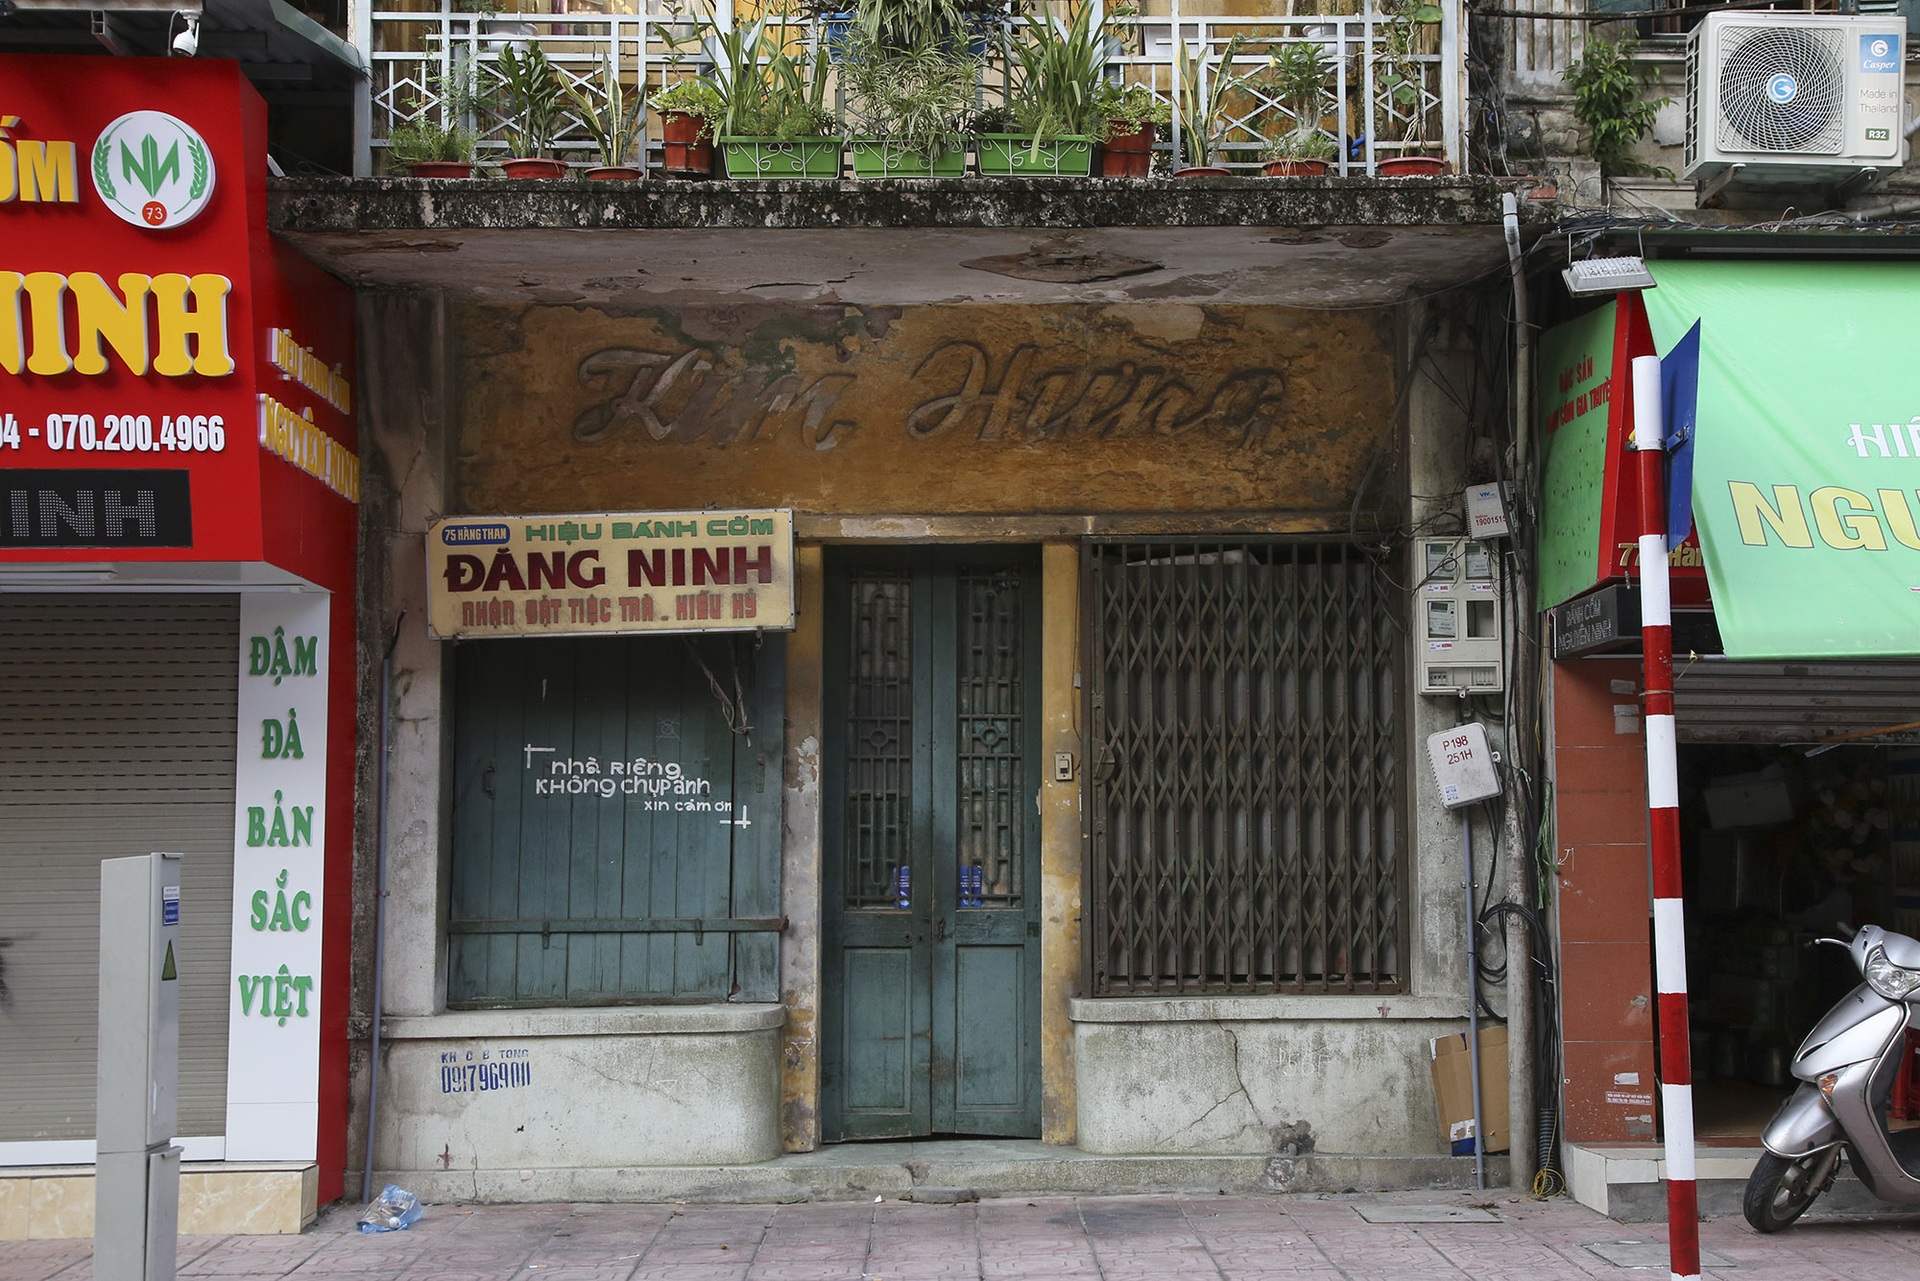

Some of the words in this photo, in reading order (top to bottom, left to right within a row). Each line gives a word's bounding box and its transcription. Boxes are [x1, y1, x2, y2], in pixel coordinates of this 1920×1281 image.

[1863, 60, 1895, 71] Casper
[1860, 90, 1886, 99] Made
[1889, 90, 1897, 99] in
[1860, 103, 1898, 113] Thailand
[1869, 131, 1886, 139] R32
[145, 207, 163, 220] 73
[0, 271, 235, 376] INH
[47, 414, 225, 451] 070.200.4966
[0, 490, 156, 536] INH
[525, 521, 602, 546] HIỆU
[612, 520, 698, 539] BÁNH
[706, 515, 774, 536] CỐM
[445, 530, 456, 541] 75
[458, 527, 481, 540] HÀNG
[482, 528, 506, 540] THAN
[443, 547, 606, 592] ĐĂNG
[627, 546, 772, 588] NINH
[462, 596, 515, 629] NHẬN
[525, 594, 562, 628] ĐẶT
[568, 593, 611, 626] TIỆC
[676, 589, 721, 621] HIẾU
[249, 625, 318, 686] ĐẬM
[261, 707, 304, 759] ĐÀ
[1443, 735, 1469, 751] P198
[1447, 748, 1473, 765] 251H
[246, 789, 314, 848] BẢN
[250, 868, 311, 932] SẮC
[237, 963, 313, 1027] VIỆT
